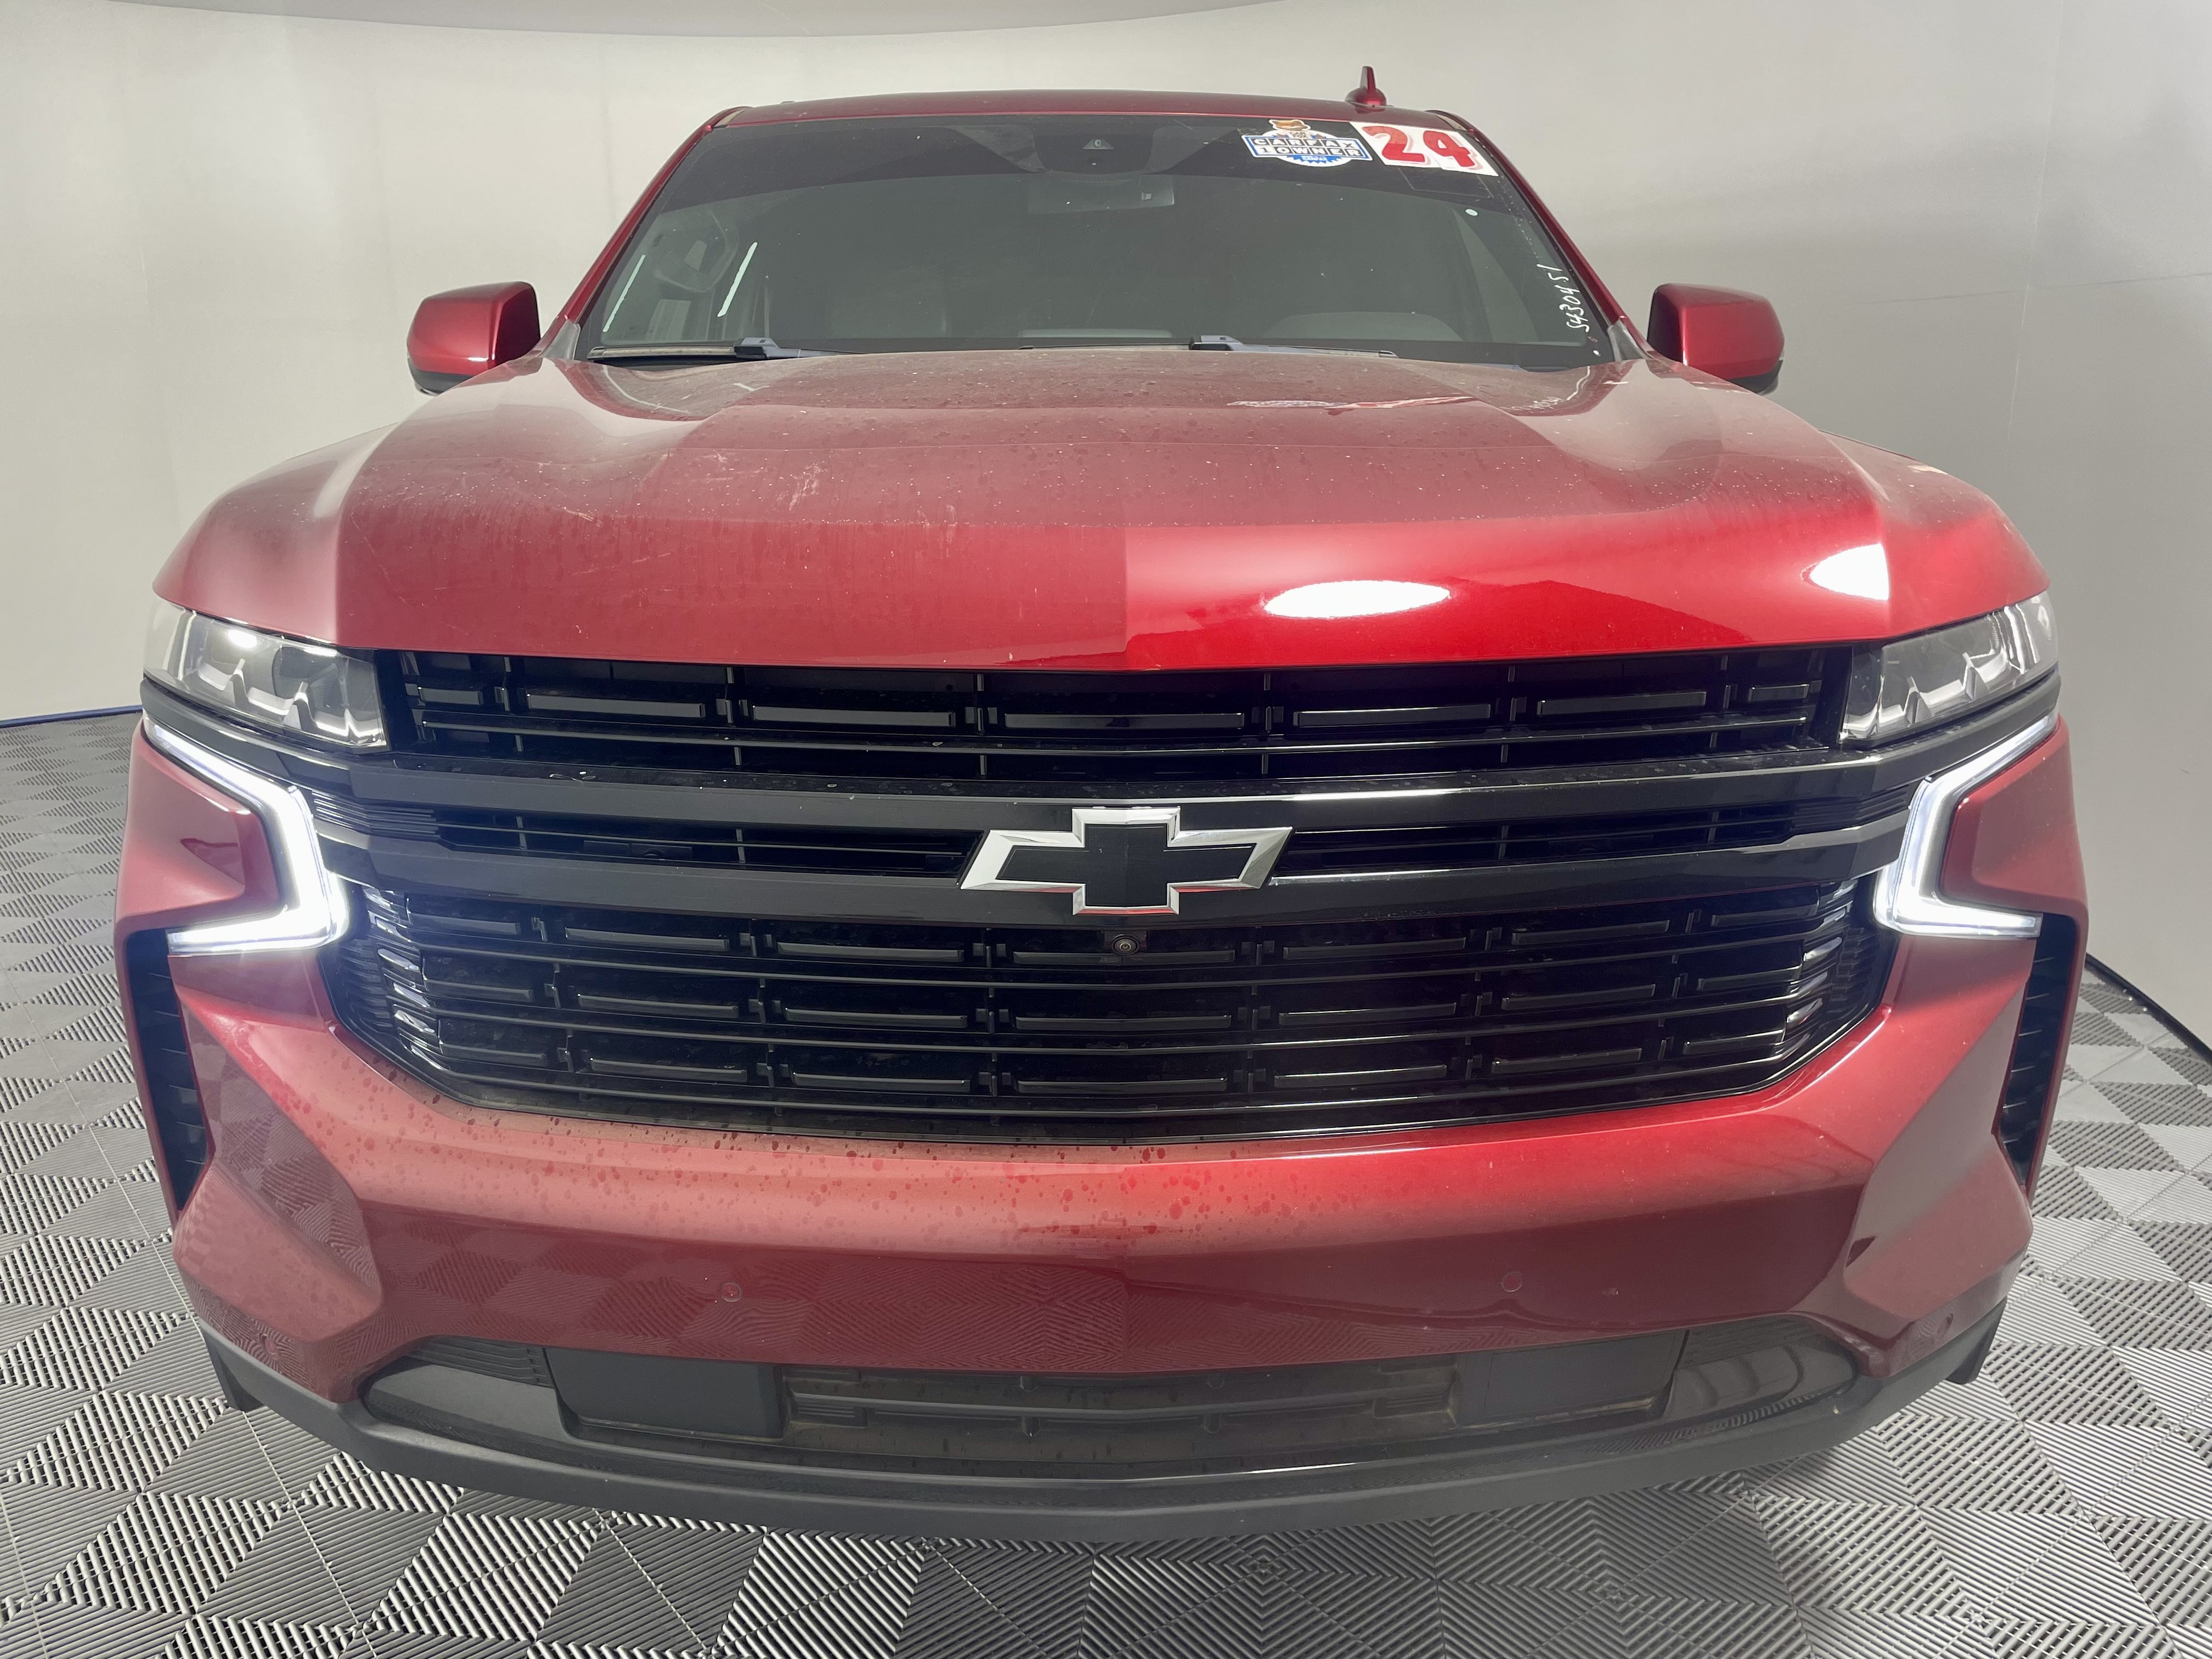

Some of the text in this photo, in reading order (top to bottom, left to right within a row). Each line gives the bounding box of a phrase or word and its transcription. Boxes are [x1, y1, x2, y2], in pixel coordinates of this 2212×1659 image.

[1252, 138, 1355, 148] CARFAX
[1363, 126, 1476, 167] 24
[1278, 146, 1361, 156] OWNER
